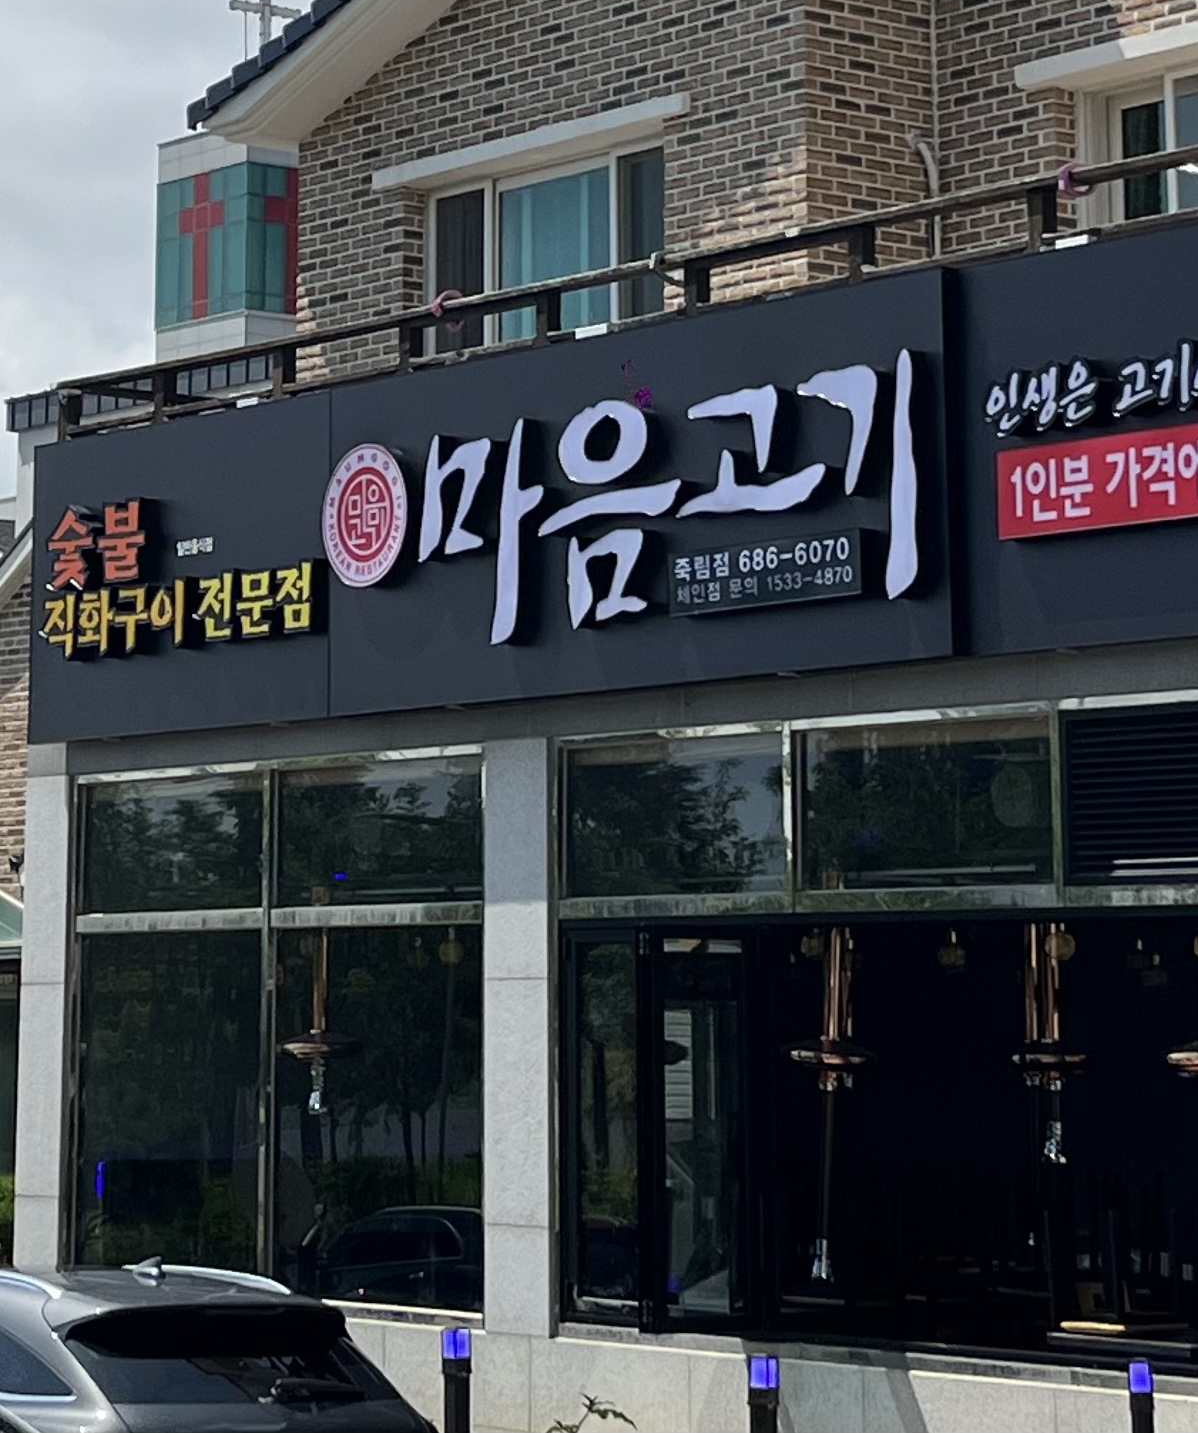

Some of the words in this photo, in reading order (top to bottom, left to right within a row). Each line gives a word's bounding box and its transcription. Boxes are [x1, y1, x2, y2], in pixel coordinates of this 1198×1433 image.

[987, 362, 1095, 434] 인생은
[418, 348, 918, 645] 마음고기
[1010, 455, 1094, 522] 1인분
[48, 500, 145, 590] 숯불
[674, 552, 729, 581] 죽림점
[738, 537, 849, 573] 686-6070
[40, 588, 186, 658] 직화구이
[194, 560, 312, 638] 전문점
[677, 581, 721, 604] 체인점
[729, 576, 758, 599] 문의
[767, 566, 853, 592] 1533-4870
